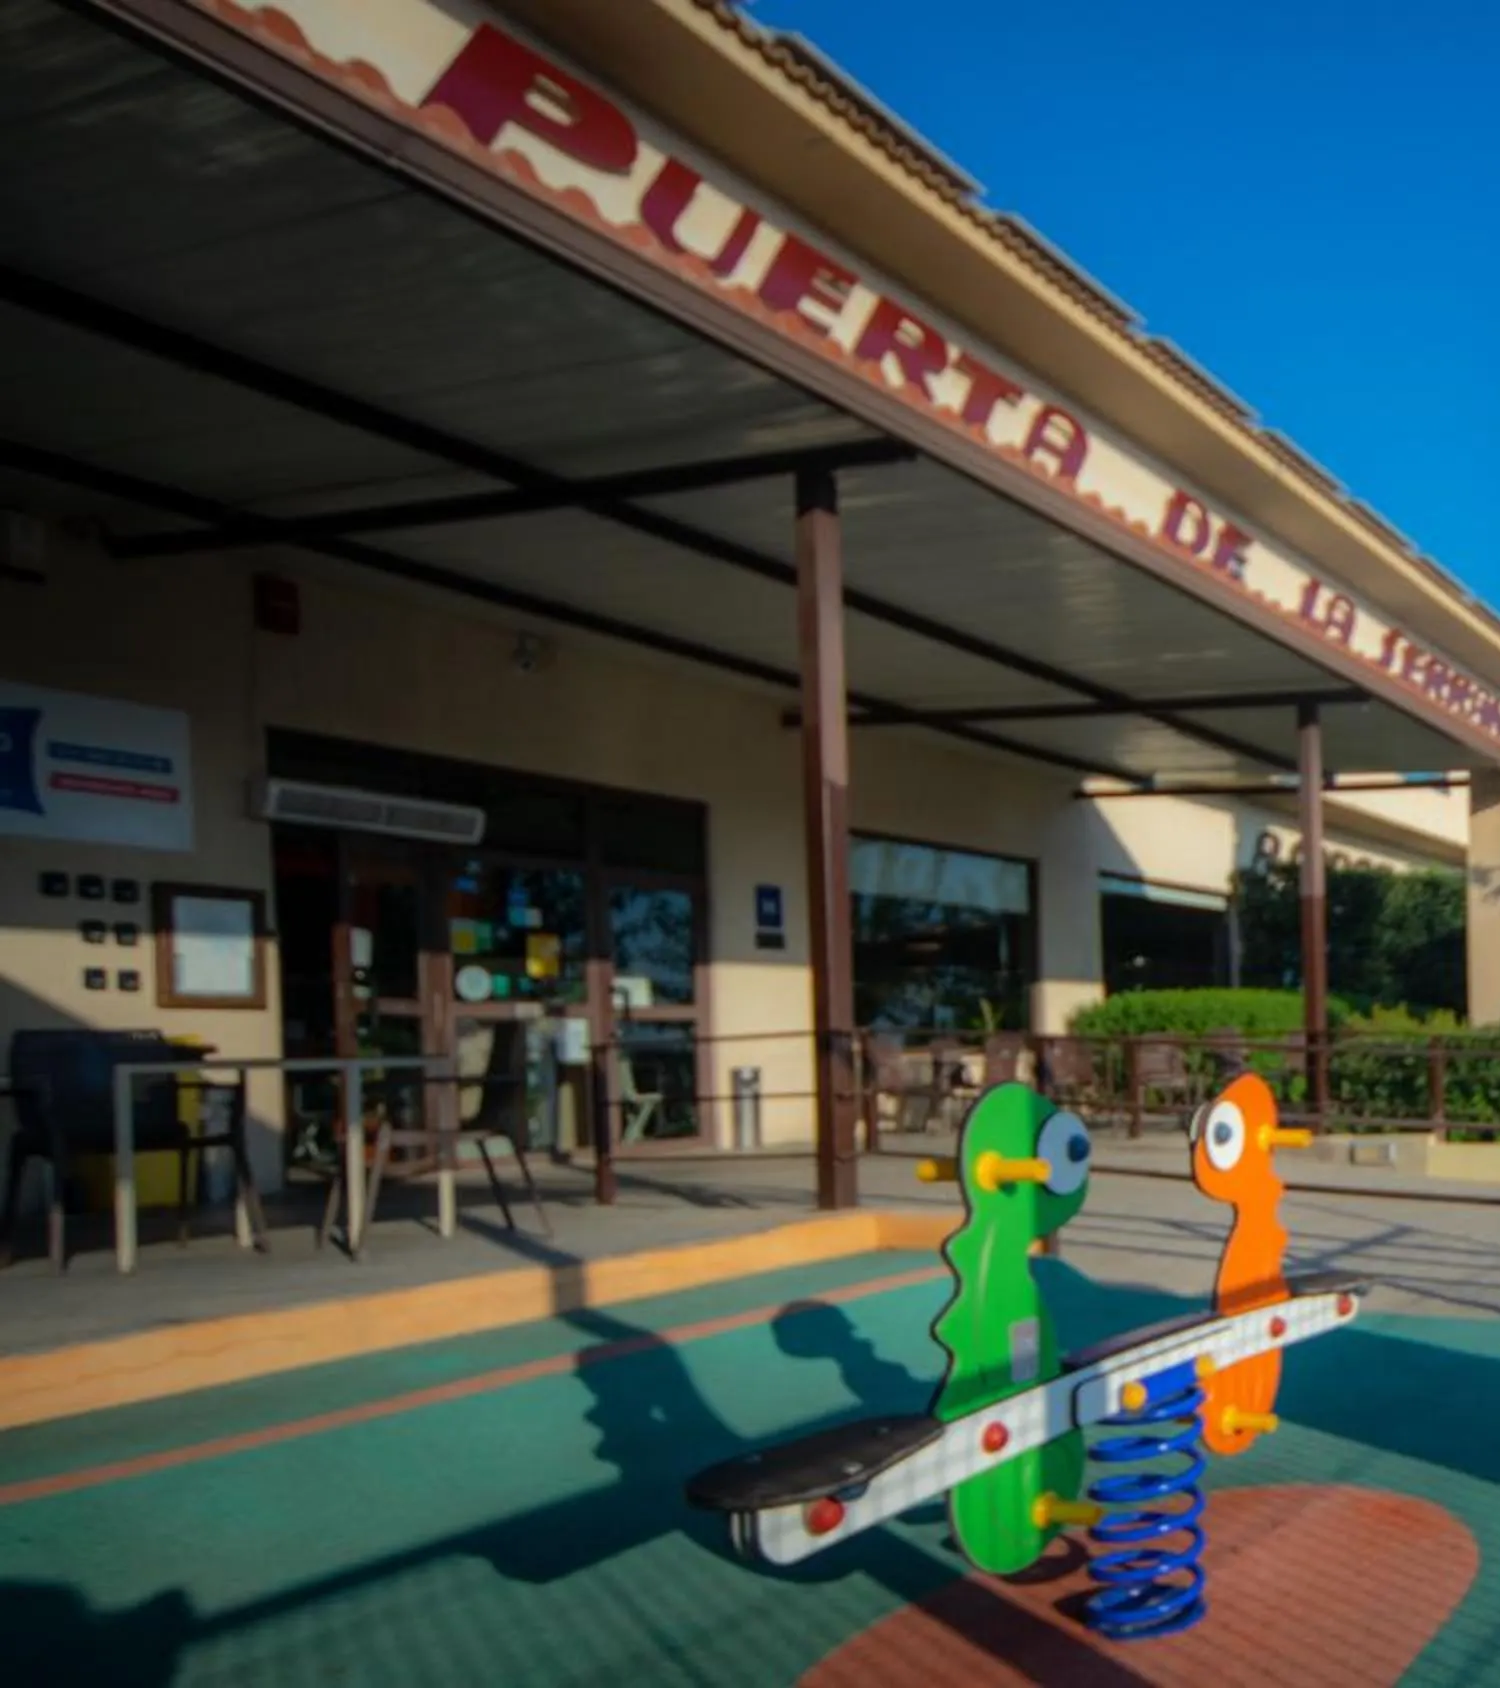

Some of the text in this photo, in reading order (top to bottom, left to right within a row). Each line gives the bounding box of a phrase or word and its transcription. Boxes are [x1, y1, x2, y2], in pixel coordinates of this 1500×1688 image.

[417, 22, 1090, 478] PUERTA
[1162, 488, 1252, 580] DE
[1299, 576, 1357, 648] LA
